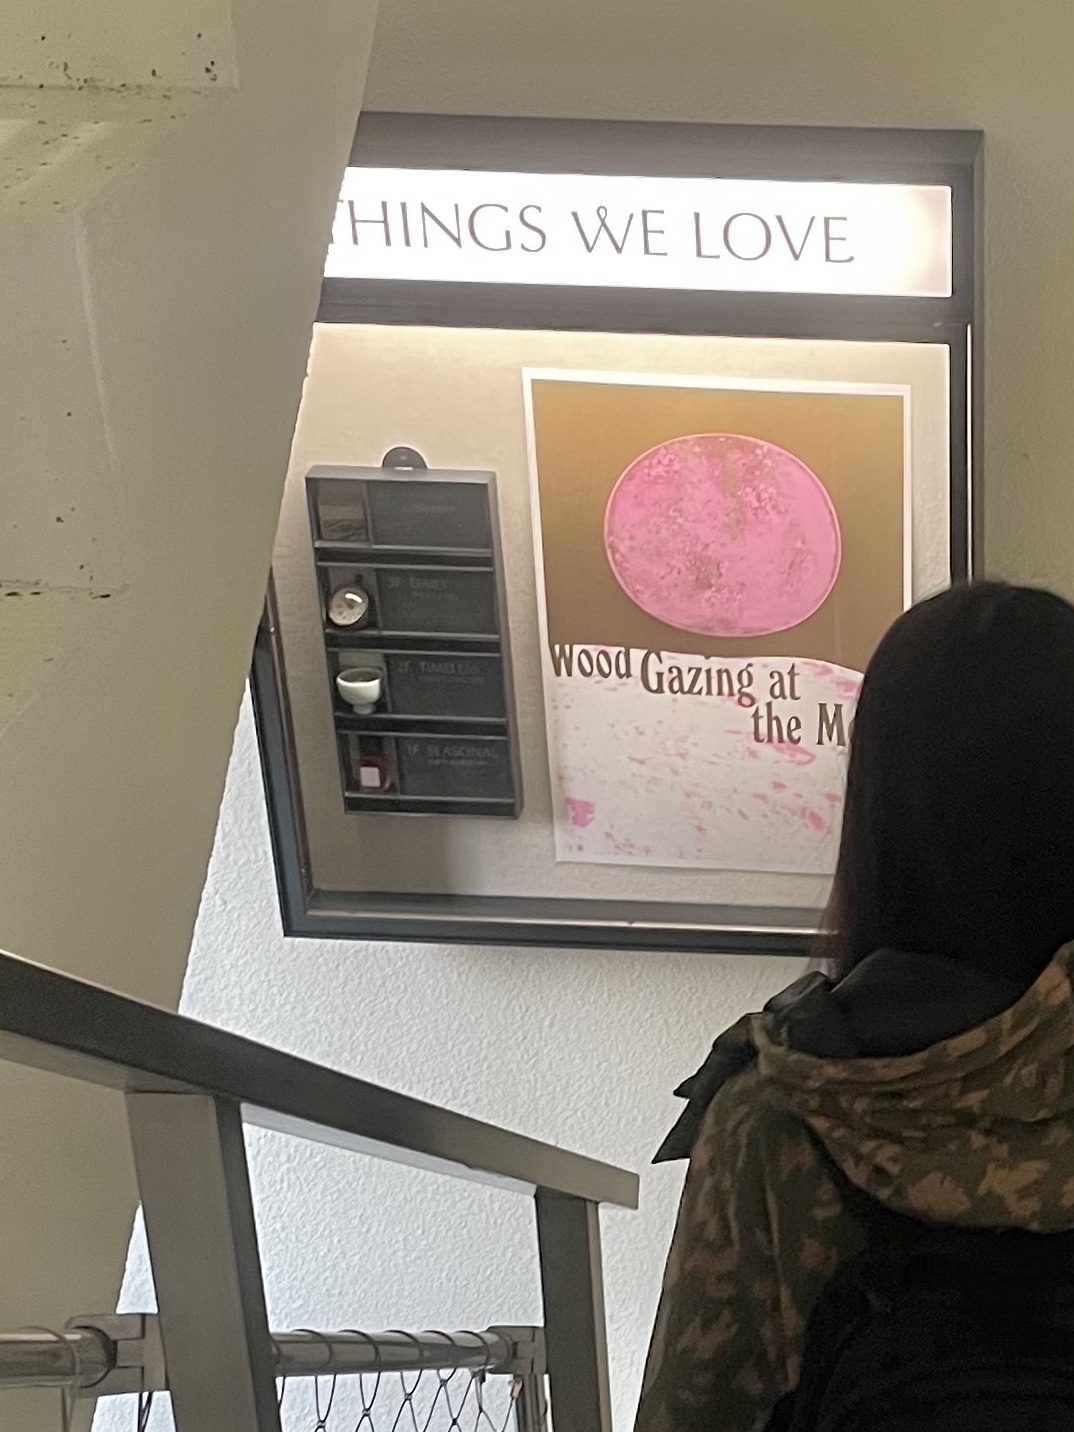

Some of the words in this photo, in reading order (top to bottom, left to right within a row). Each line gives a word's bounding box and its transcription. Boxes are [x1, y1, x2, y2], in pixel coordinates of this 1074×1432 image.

[571, 205, 668, 256] WE
[693, 211, 855, 263] LOVE
[550, 645, 632, 679] Wood
[640, 650, 756, 708] Gazing
[769, 663, 801, 701] at
[751, 701, 802, 745] the
